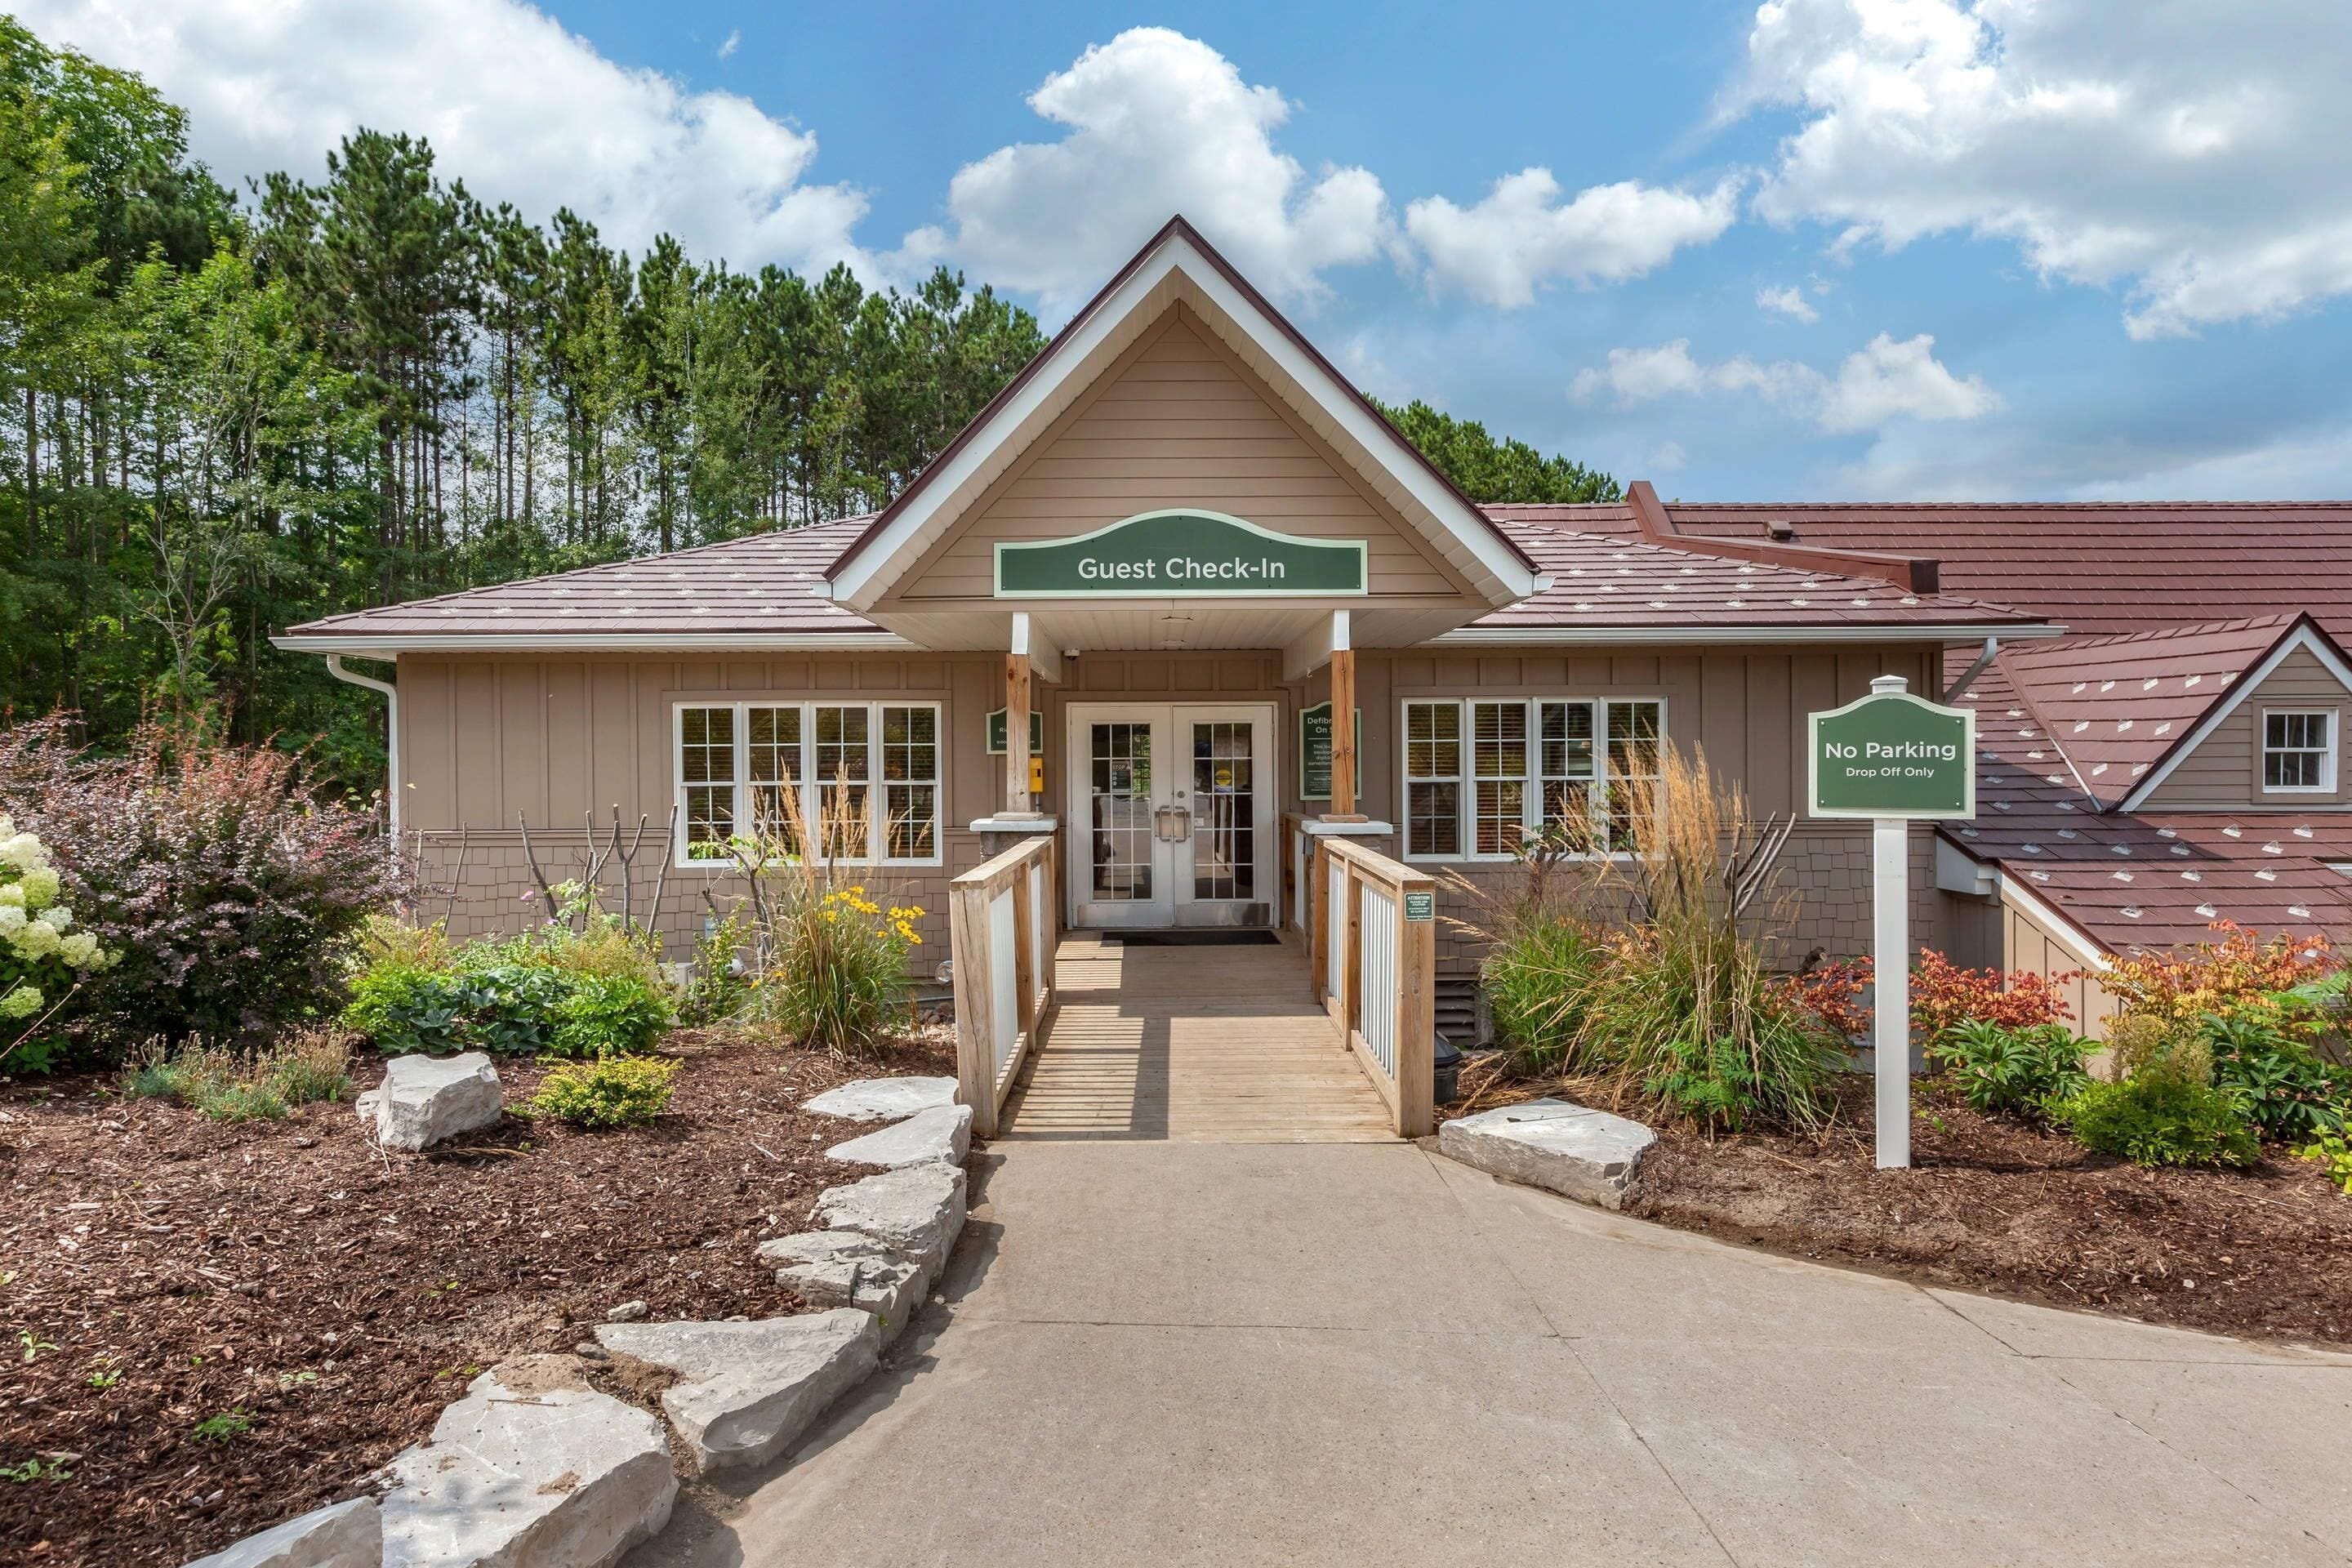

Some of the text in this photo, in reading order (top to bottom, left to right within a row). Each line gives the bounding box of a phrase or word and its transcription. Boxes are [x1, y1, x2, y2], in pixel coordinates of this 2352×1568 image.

[1078, 557, 1285, 579] Guest Check-In
[1307, 717, 1332, 725] Defibr
[1825, 742, 1957, 761] No Parking
[1846, 767, 1935, 778] Drop Off Only
